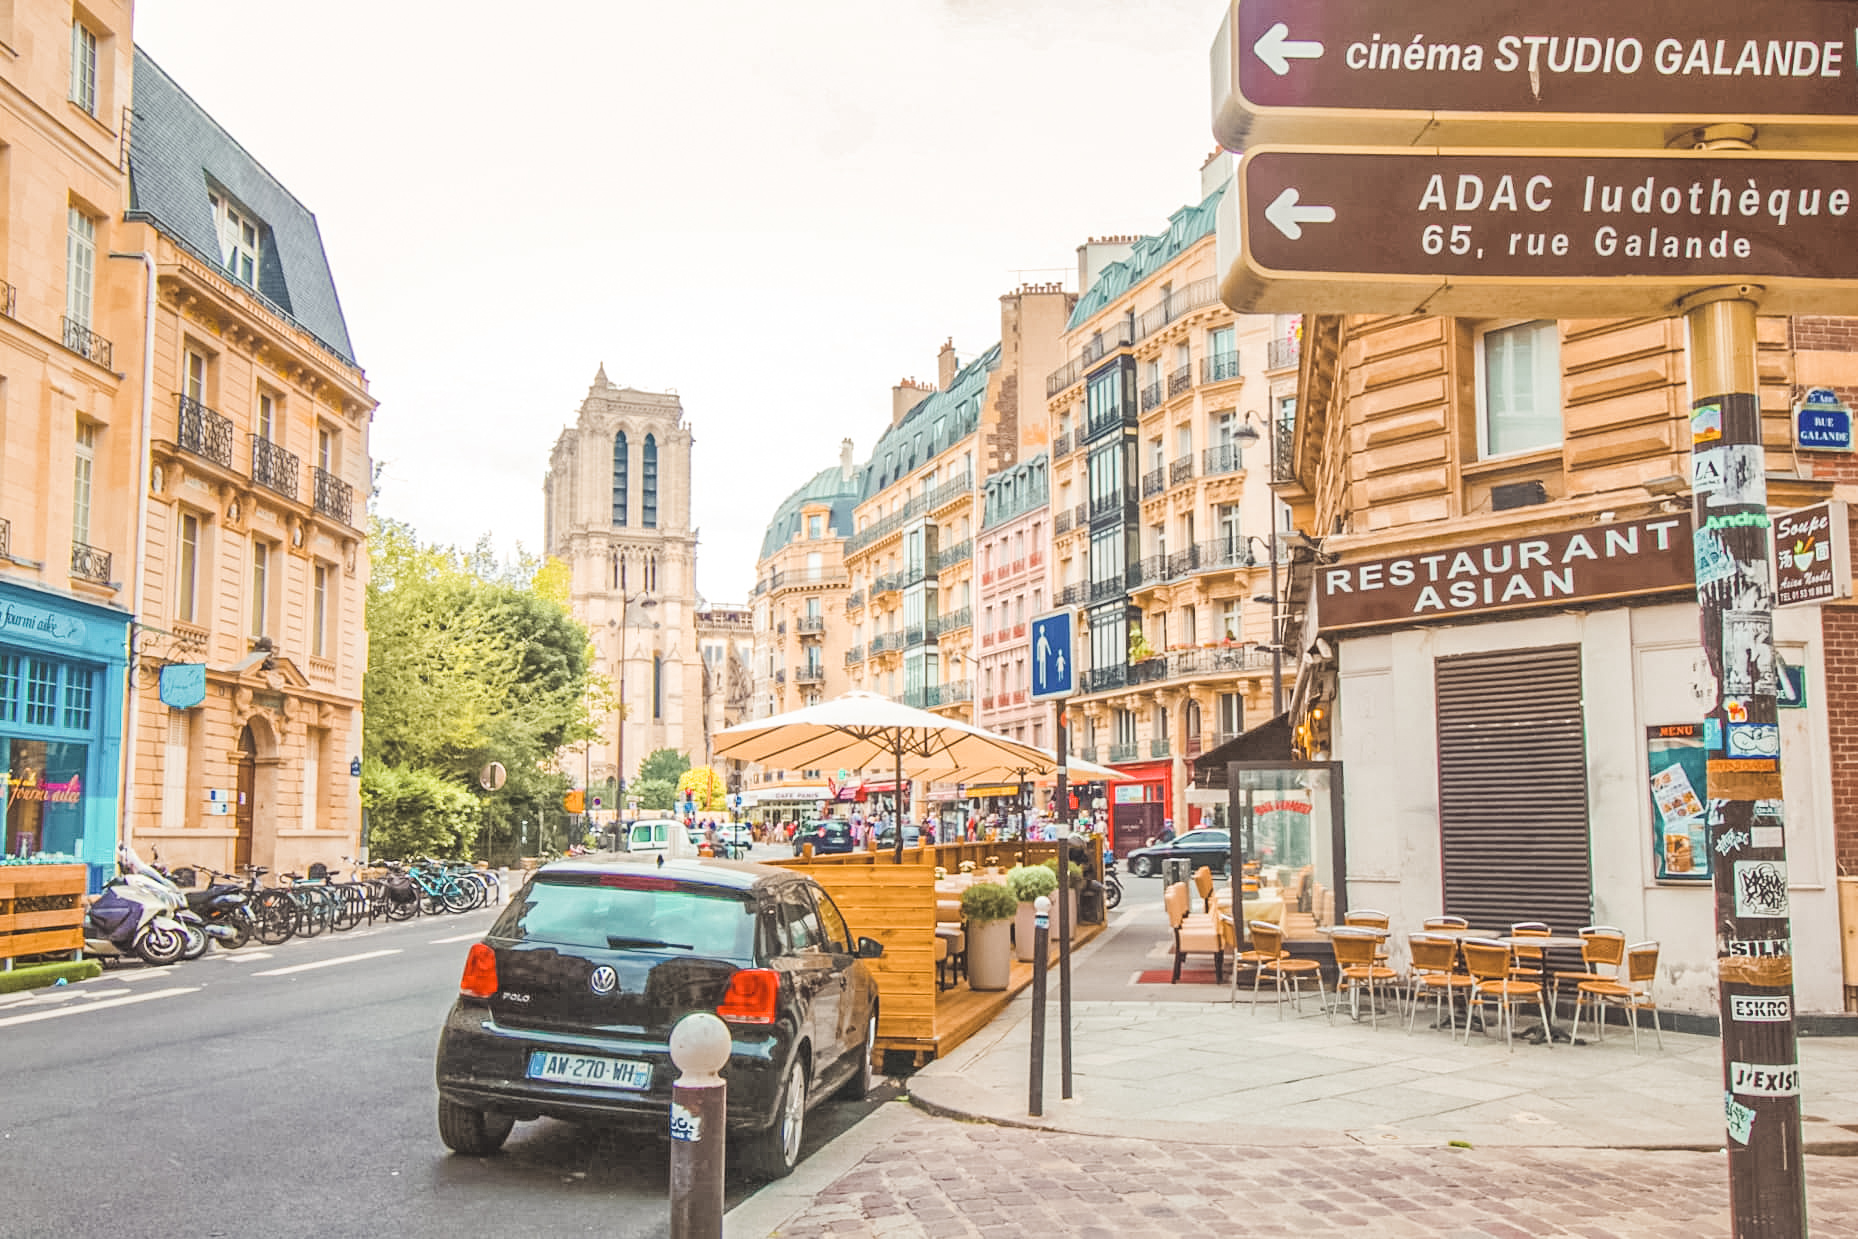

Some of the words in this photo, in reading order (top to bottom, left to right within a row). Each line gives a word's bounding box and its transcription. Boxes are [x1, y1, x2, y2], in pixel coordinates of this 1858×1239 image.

[1346, 33, 1484, 71] cinéma
[1494, 35, 1643, 75] STUDIO
[1654, 38, 1844, 78] GALANDE
[1419, 174, 1554, 212] ADAC
[1583, 175, 1851, 226] ludothèque
[1422, 225, 1485, 259] 65,
[1508, 231, 1570, 257] rue
[1595, 226, 1753, 259] Galande
[1814, 416, 1834, 428] RUE
[1800, 430, 1849, 442] GALANDE
[1777, 516, 1828, 539] Soupe
[1326, 519, 1680, 596] RESTAURANT
[1413, 566, 1575, 613] ASIAN
[1660, 725, 1694, 737] MENU
[502, 991, 531, 1003] POLO
[1735, 1000, 1788, 1017] ESKRO
[547, 1055, 635, 1082] AW-270-WH
